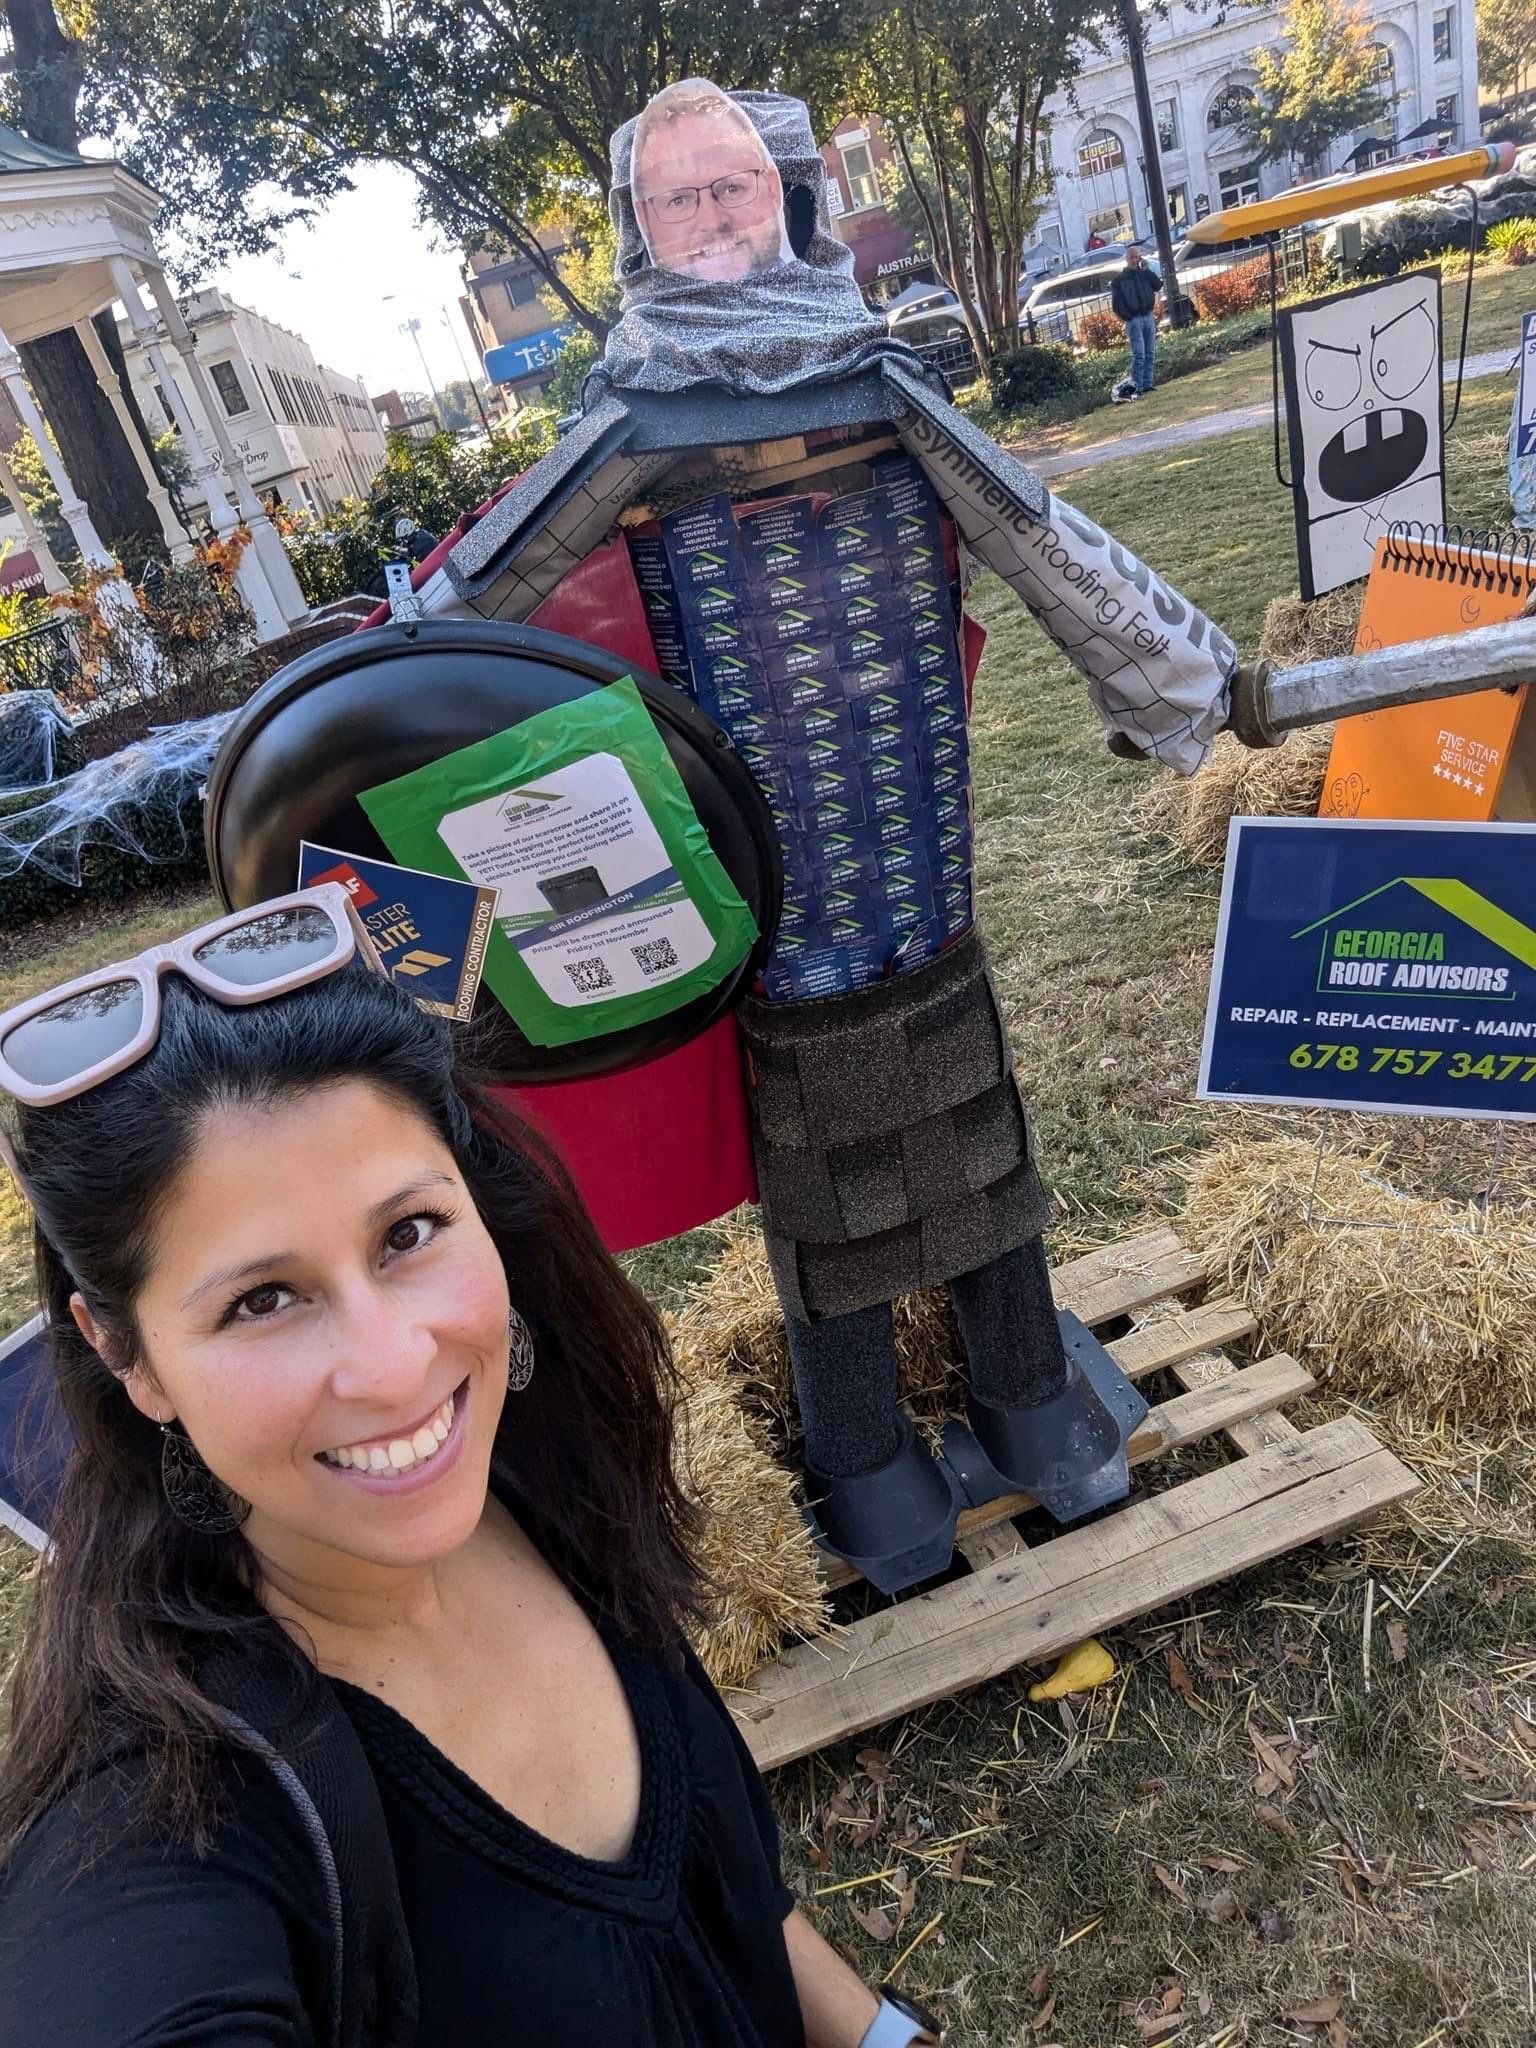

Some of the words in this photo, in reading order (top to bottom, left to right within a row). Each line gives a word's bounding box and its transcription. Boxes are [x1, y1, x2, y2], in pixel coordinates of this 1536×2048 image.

[245, 450, 269, 464] Drop
[1032, 526, 1125, 627] Roofing
[1121, 610, 1170, 660] Felt
[1436, 729, 1466, 751] FIVE
[1467, 741, 1500, 766] STAR
[1440, 748, 1488, 777] SERVICE
[461, 851, 479, 861] Take
[486, 841, 512, 857] picture
[513, 837, 521, 846] of
[521, 834, 534, 843] our
[535, 821, 573, 839] scarecrow
[574, 814, 588, 825] and
[589, 806, 611, 818] share
[611, 800, 618, 809] it
[619, 796, 629, 806] on
[469, 858, 490, 869] social
[516, 841, 544, 856] tagging
[544, 838, 554, 846] us
[554, 832, 566, 843] for
[572, 822, 599, 837] chance
[600, 817, 608, 826] to
[608, 809, 627, 821] WIN
[478, 865, 495, 875] YETI
[495, 858, 521, 871] Tundra
[557, 838, 585, 854] perfect
[585, 832, 597, 843] for
[522, 858, 551, 874] keeping
[552, 853, 566, 864] you
[567, 847, 583, 858] cool
[583, 839, 608, 853] during
[609, 829, 634, 844] school
[538, 864, 561, 876] sports
[364, 902, 411, 931] STER
[548, 921, 566, 933] SIR
[567, 891, 635, 926] ROOFINGTON
[371, 920, 422, 954] LITE
[531, 943, 553, 955] Prize
[553, 938, 570, 948] will
[570, 935, 580, 945] be
[581, 929, 608, 942] drawn
[609, 922, 626, 935] and
[626, 907, 674, 928] announced
[566, 943, 593, 955] Friday
[606, 926, 649, 945] November
[1333, 929, 1445, 961] GEORGIA
[456, 974, 476, 1019] ROOFING
[467, 901, 493, 971] CONTRACTOR
[1328, 960, 1389, 987] ROOF
[1392, 963, 1509, 992] ADVISORS
[1230, 1006, 1298, 1025] REPAIR
[1315, 1011, 1460, 1033] REPLACEMENT
[1289, 1043, 1360, 1072] 678
[1368, 1047, 1443, 1076] 757
[1447, 1052, 1536, 1083] 3477
